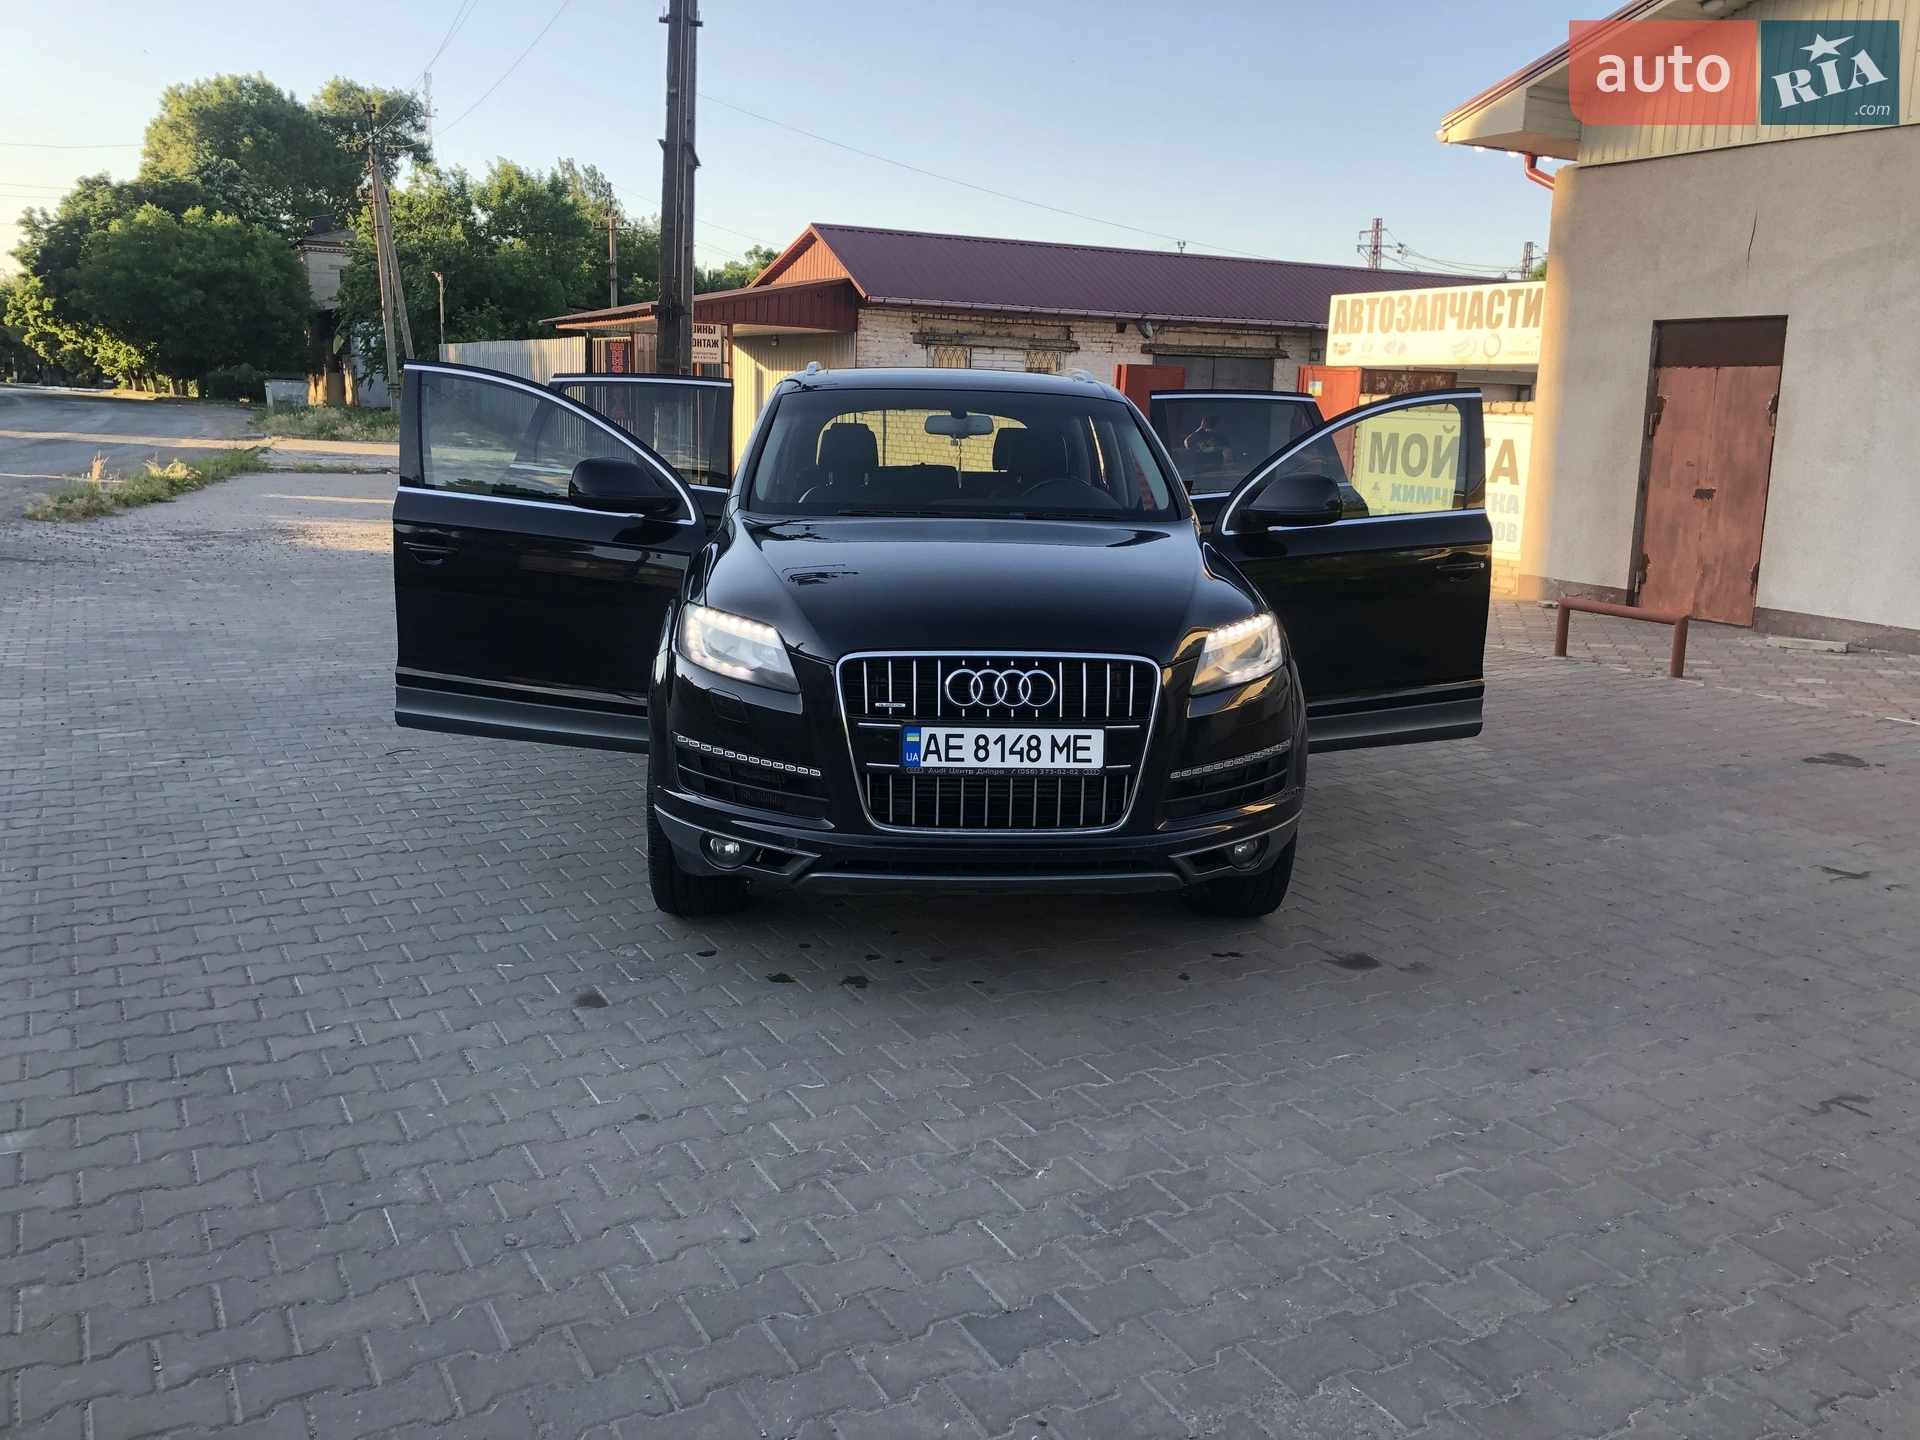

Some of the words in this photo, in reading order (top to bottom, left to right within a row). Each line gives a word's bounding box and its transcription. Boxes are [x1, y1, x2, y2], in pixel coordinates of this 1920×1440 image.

[1332, 287, 1545, 335] АВТОЗАПЧАСТИ
[692, 337, 719, 349] ОНТАЖ
[1368, 424, 1520, 486] МОЙА
[906, 752, 919, 762] UA
[922, 733, 965, 762] AE
[973, 733, 1042, 763] 8148
[1050, 734, 1093, 763] ME
